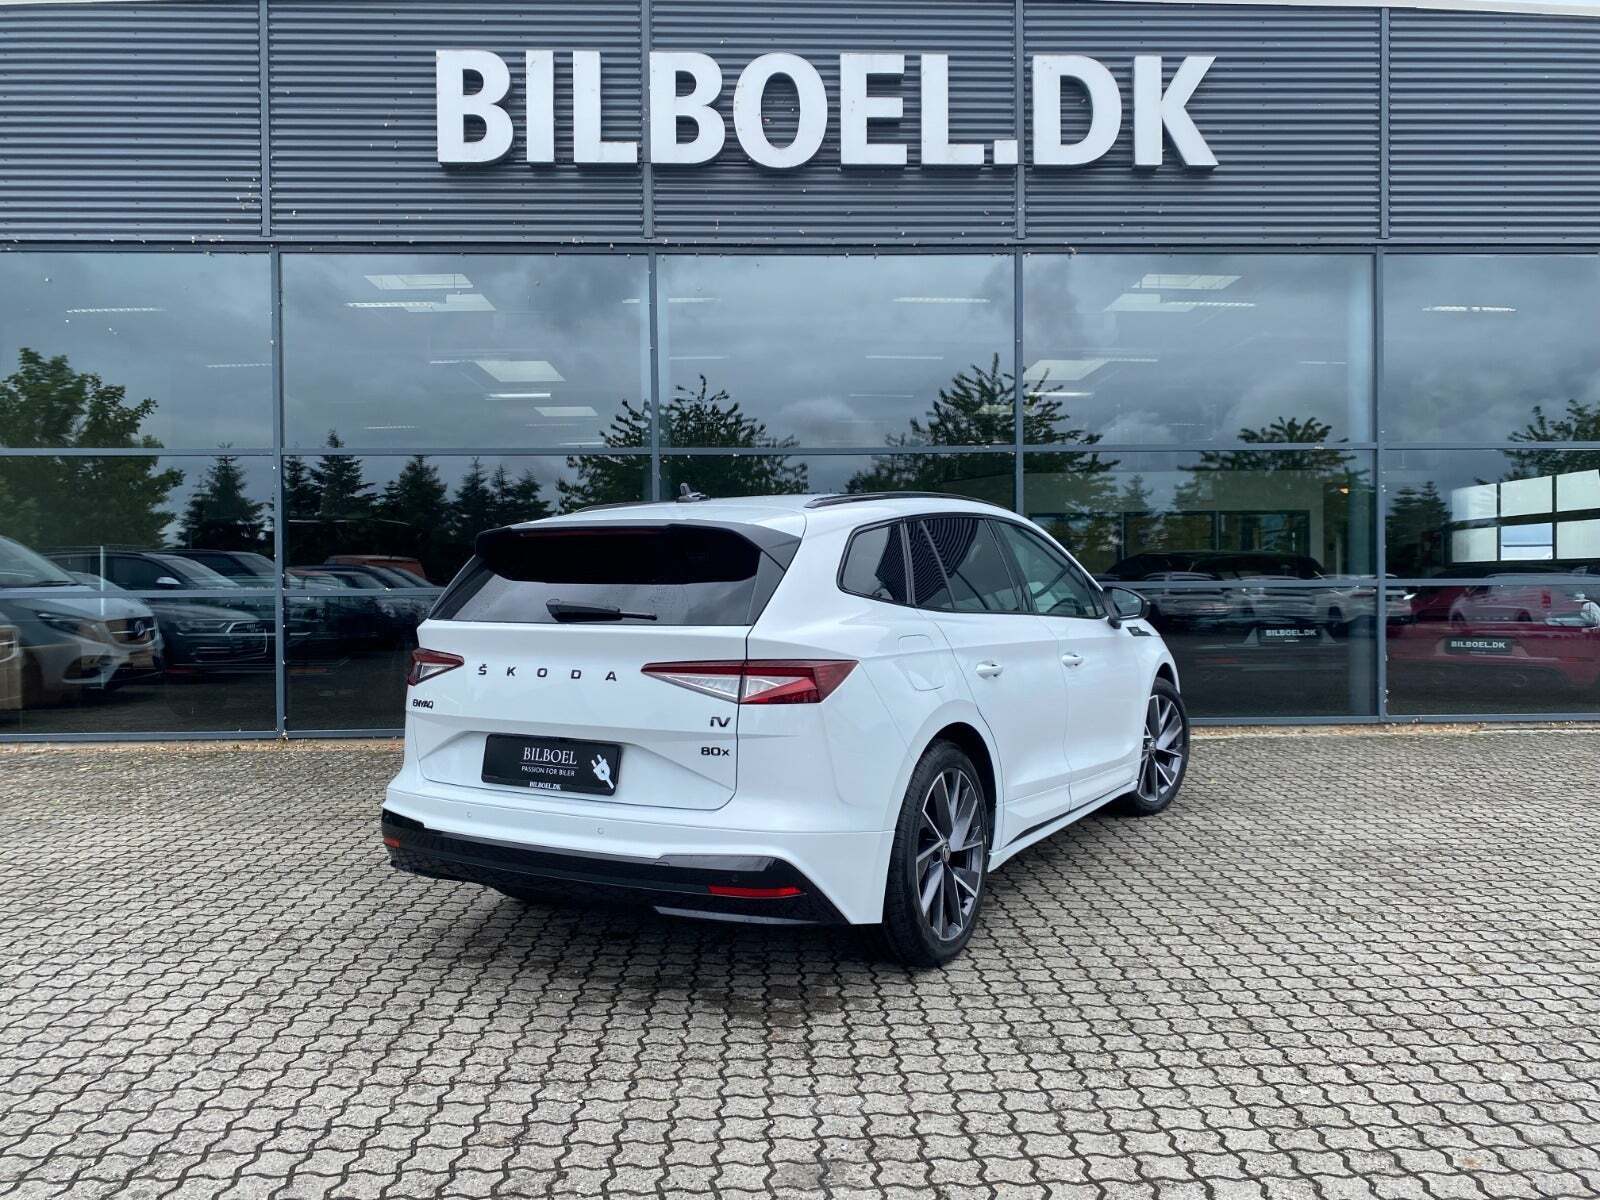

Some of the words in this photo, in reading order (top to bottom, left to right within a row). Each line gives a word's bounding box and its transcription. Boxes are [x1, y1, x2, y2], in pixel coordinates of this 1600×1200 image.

[435, 49, 1220, 169] BILBOEL.DK
[1265, 629, 1317, 637] BILBOEL.DK
[1450, 640, 1506, 649] BILBOEL.DK
[478, 663, 617, 682] ŠKODA
[523, 746, 578, 765] BILBOEL
[521, 765, 547, 775] PASSION
[546, 767, 558, 776] FOR
[558, 768, 576, 778] BILER
[529, 781, 562, 791] BILBOEL.DK
